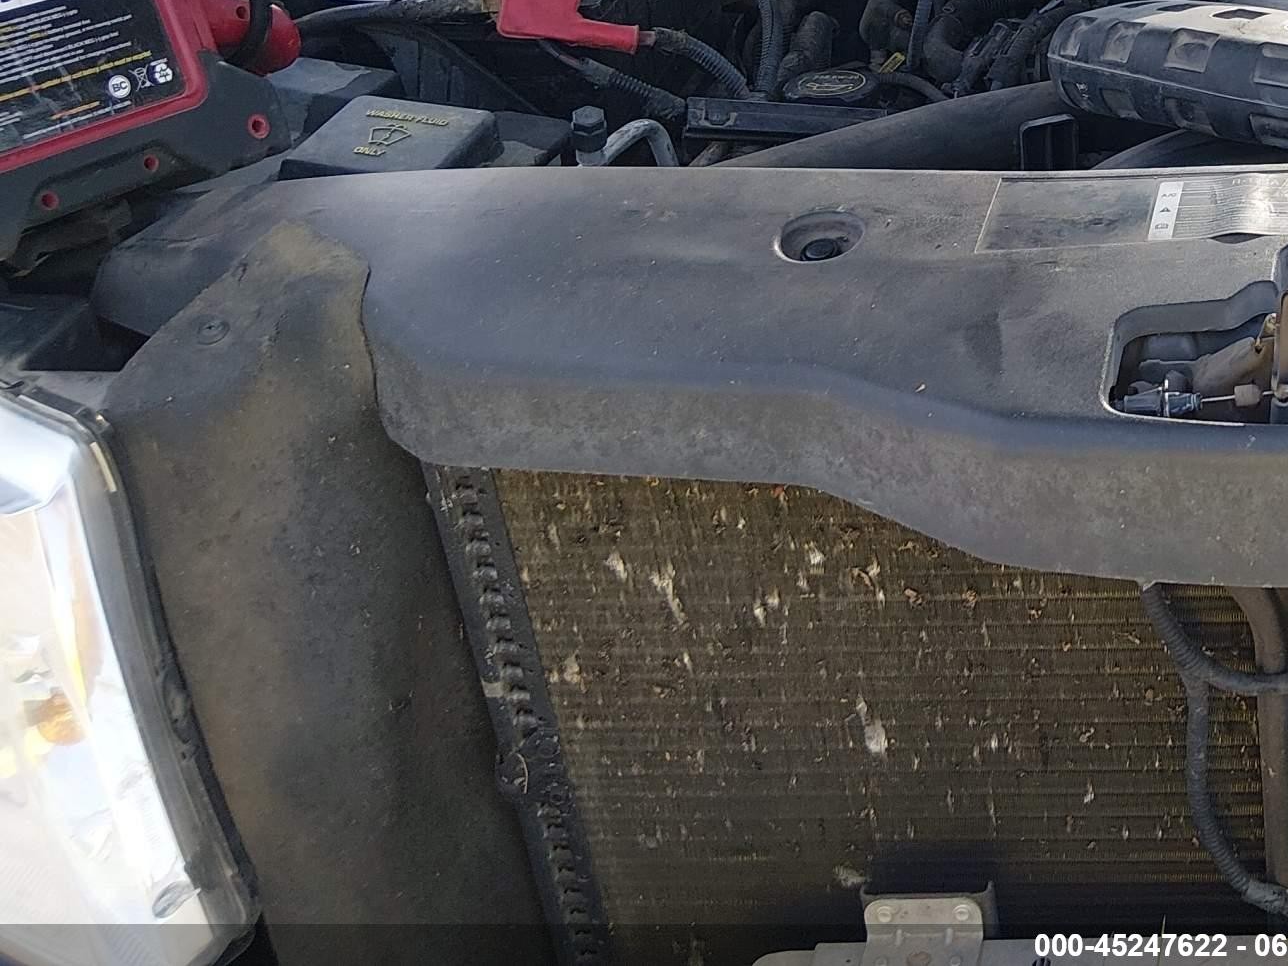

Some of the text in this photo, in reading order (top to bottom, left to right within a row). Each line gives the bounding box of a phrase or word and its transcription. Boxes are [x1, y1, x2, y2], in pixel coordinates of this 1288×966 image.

[366, 109, 449, 126] WASHER FLUID
[353, 146, 386, 157] ONLY
